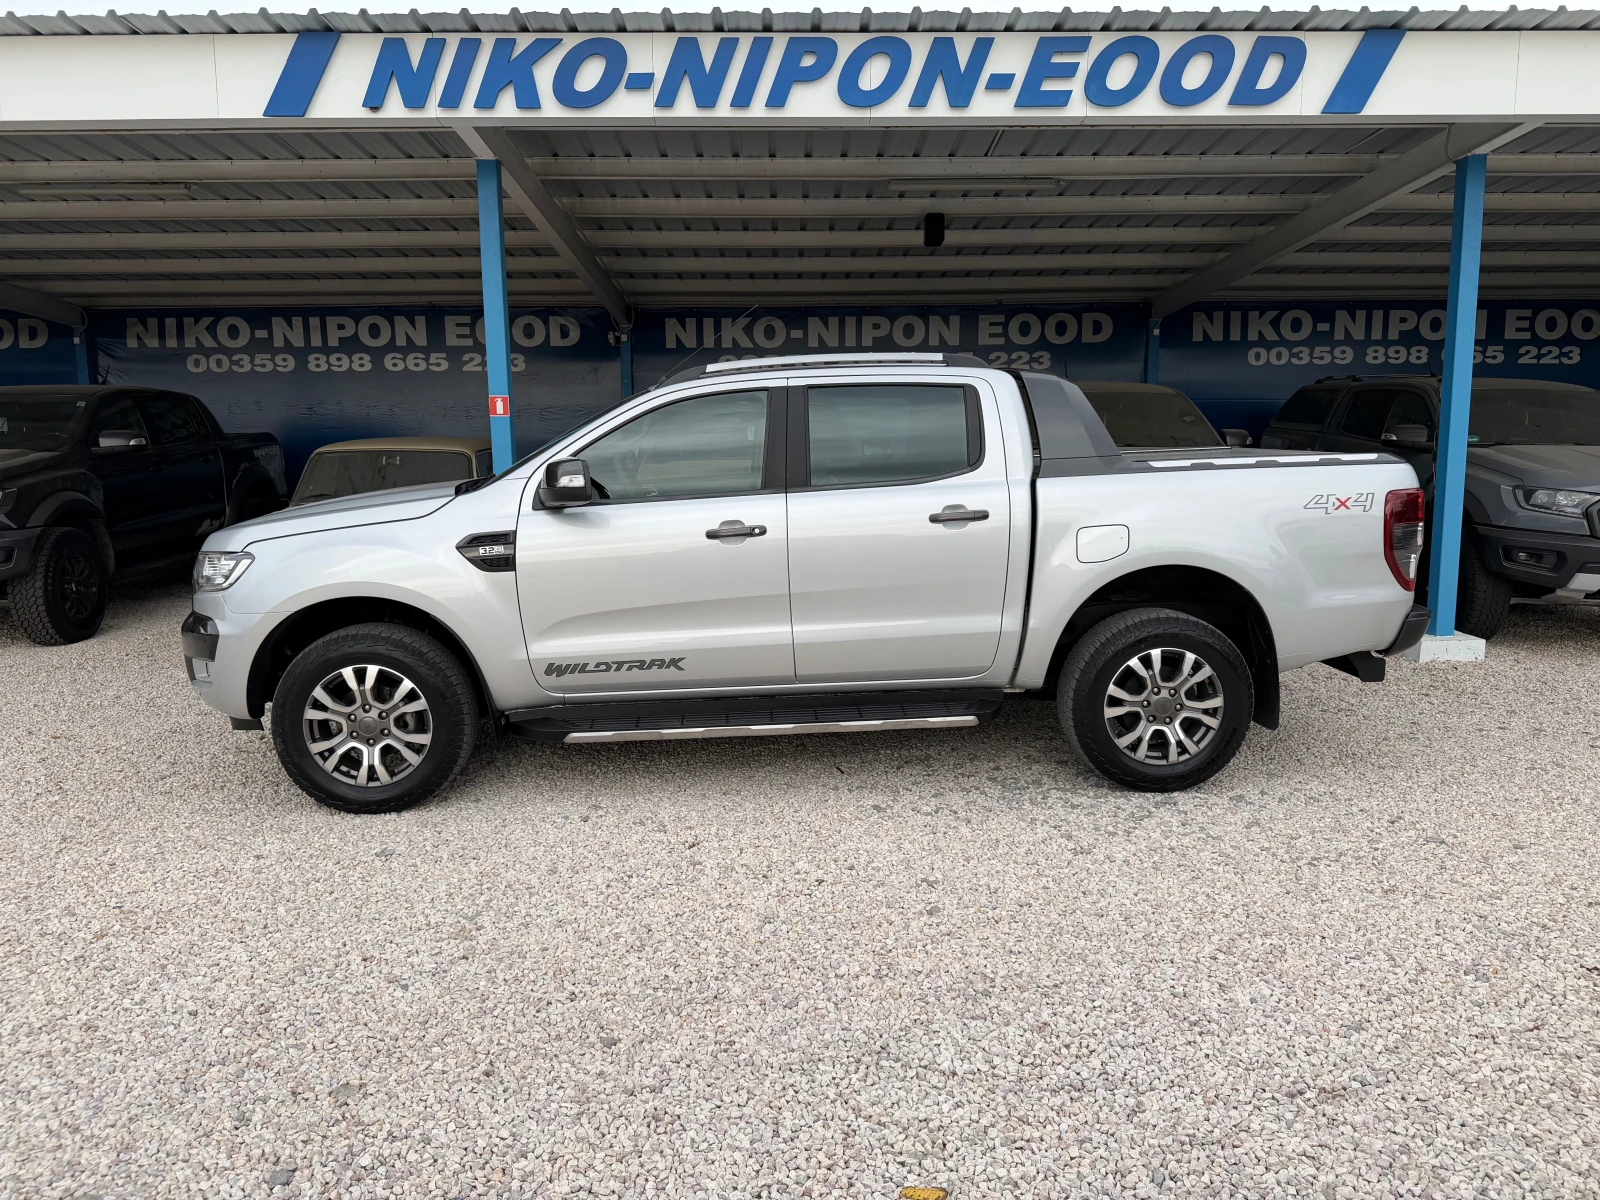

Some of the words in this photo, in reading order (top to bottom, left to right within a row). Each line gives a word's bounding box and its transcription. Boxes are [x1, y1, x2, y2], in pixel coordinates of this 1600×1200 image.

[363, 35, 1307, 109] NIKO-NIPON-EOOD
[126, 315, 428, 349] NIKO-NIPON
[665, 316, 960, 349] NIKO-NIPON
[977, 313, 1114, 346] EOOD
[186, 353, 295, 373] 00359
[308, 353, 372, 372] 898
[384, 353, 449, 372] 665
[462, 352, 526, 372] 23
[988, 351, 1052, 373] 223
[1247, 346, 1354, 366] 00359
[1365, 346, 1429, 365] 898
[1517, 346, 1581, 365] 223
[544, 656, 687, 678] WILDTRAK
